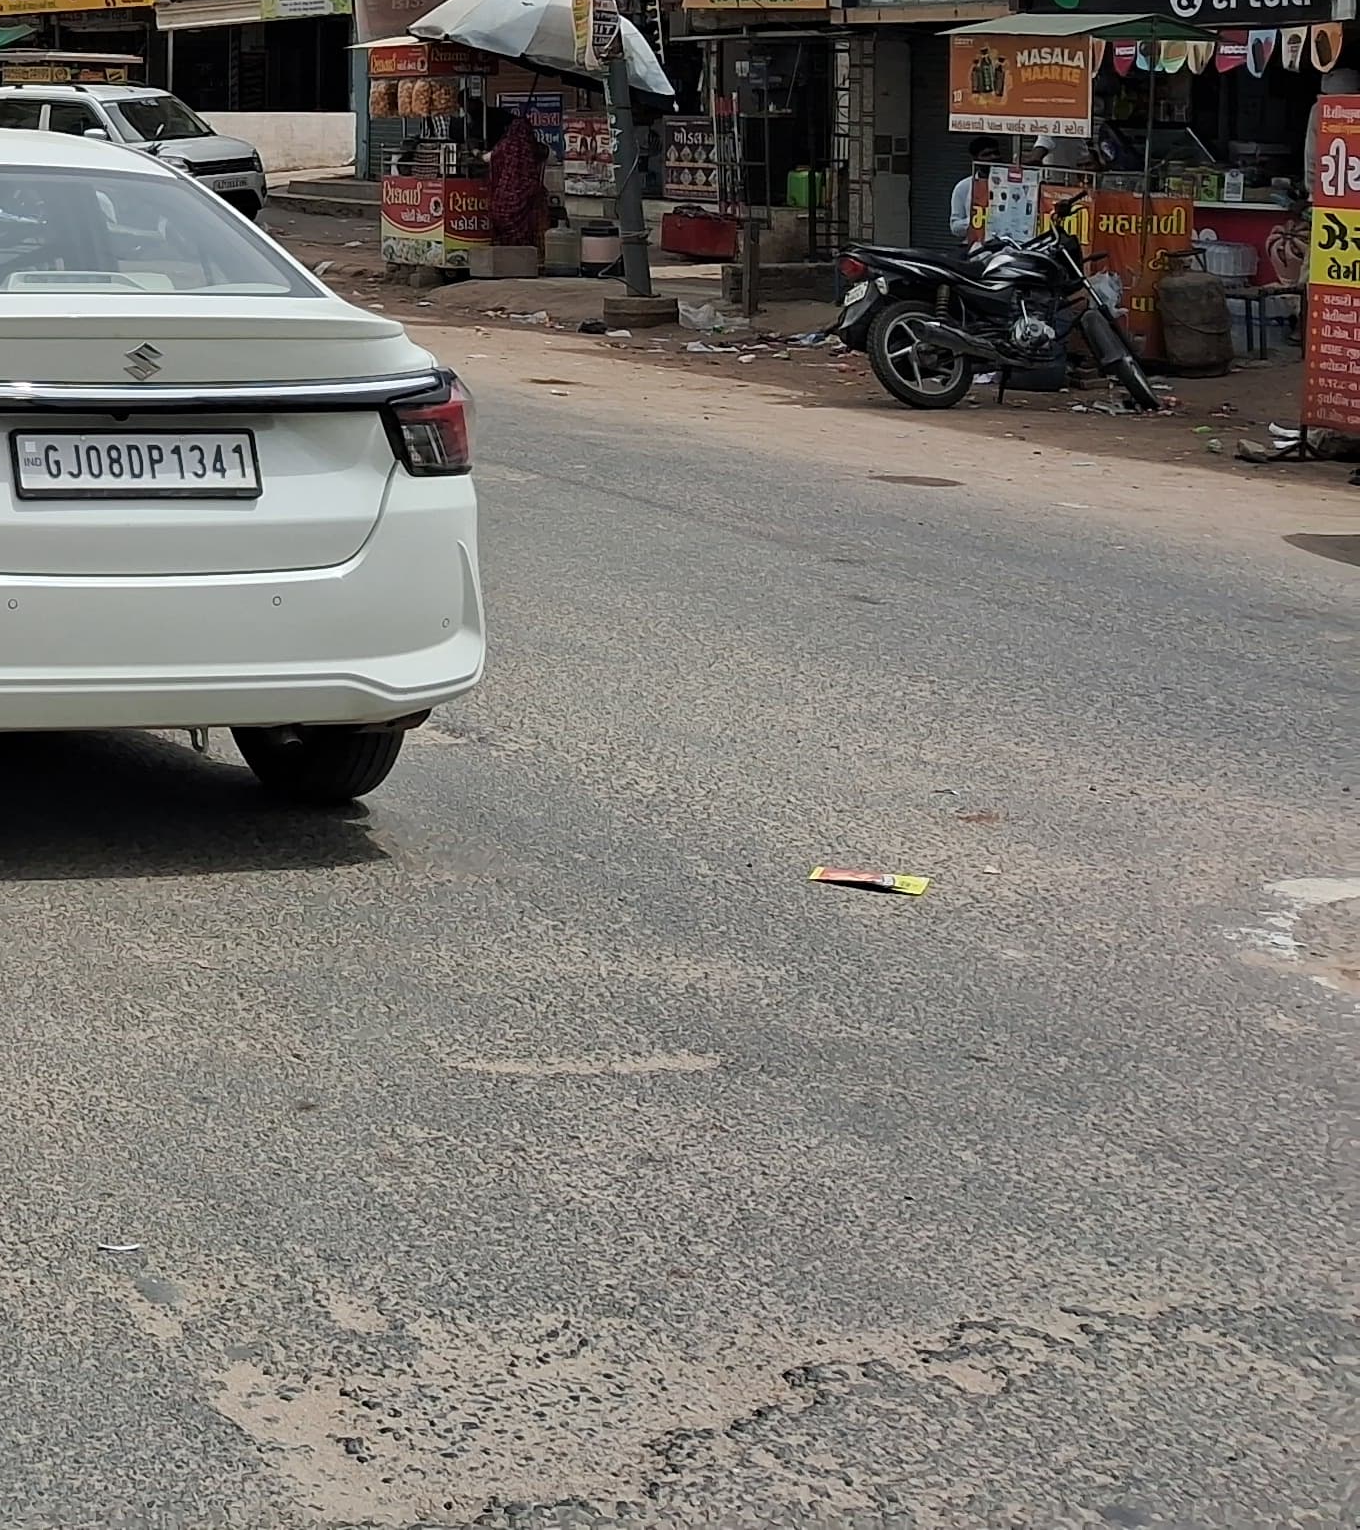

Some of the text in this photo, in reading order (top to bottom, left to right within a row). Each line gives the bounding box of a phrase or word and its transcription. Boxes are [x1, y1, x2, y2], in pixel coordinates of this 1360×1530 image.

[1016, 47, 1086, 69] MASALA
[23, 443, 248, 480] IND GJ08DP1341
